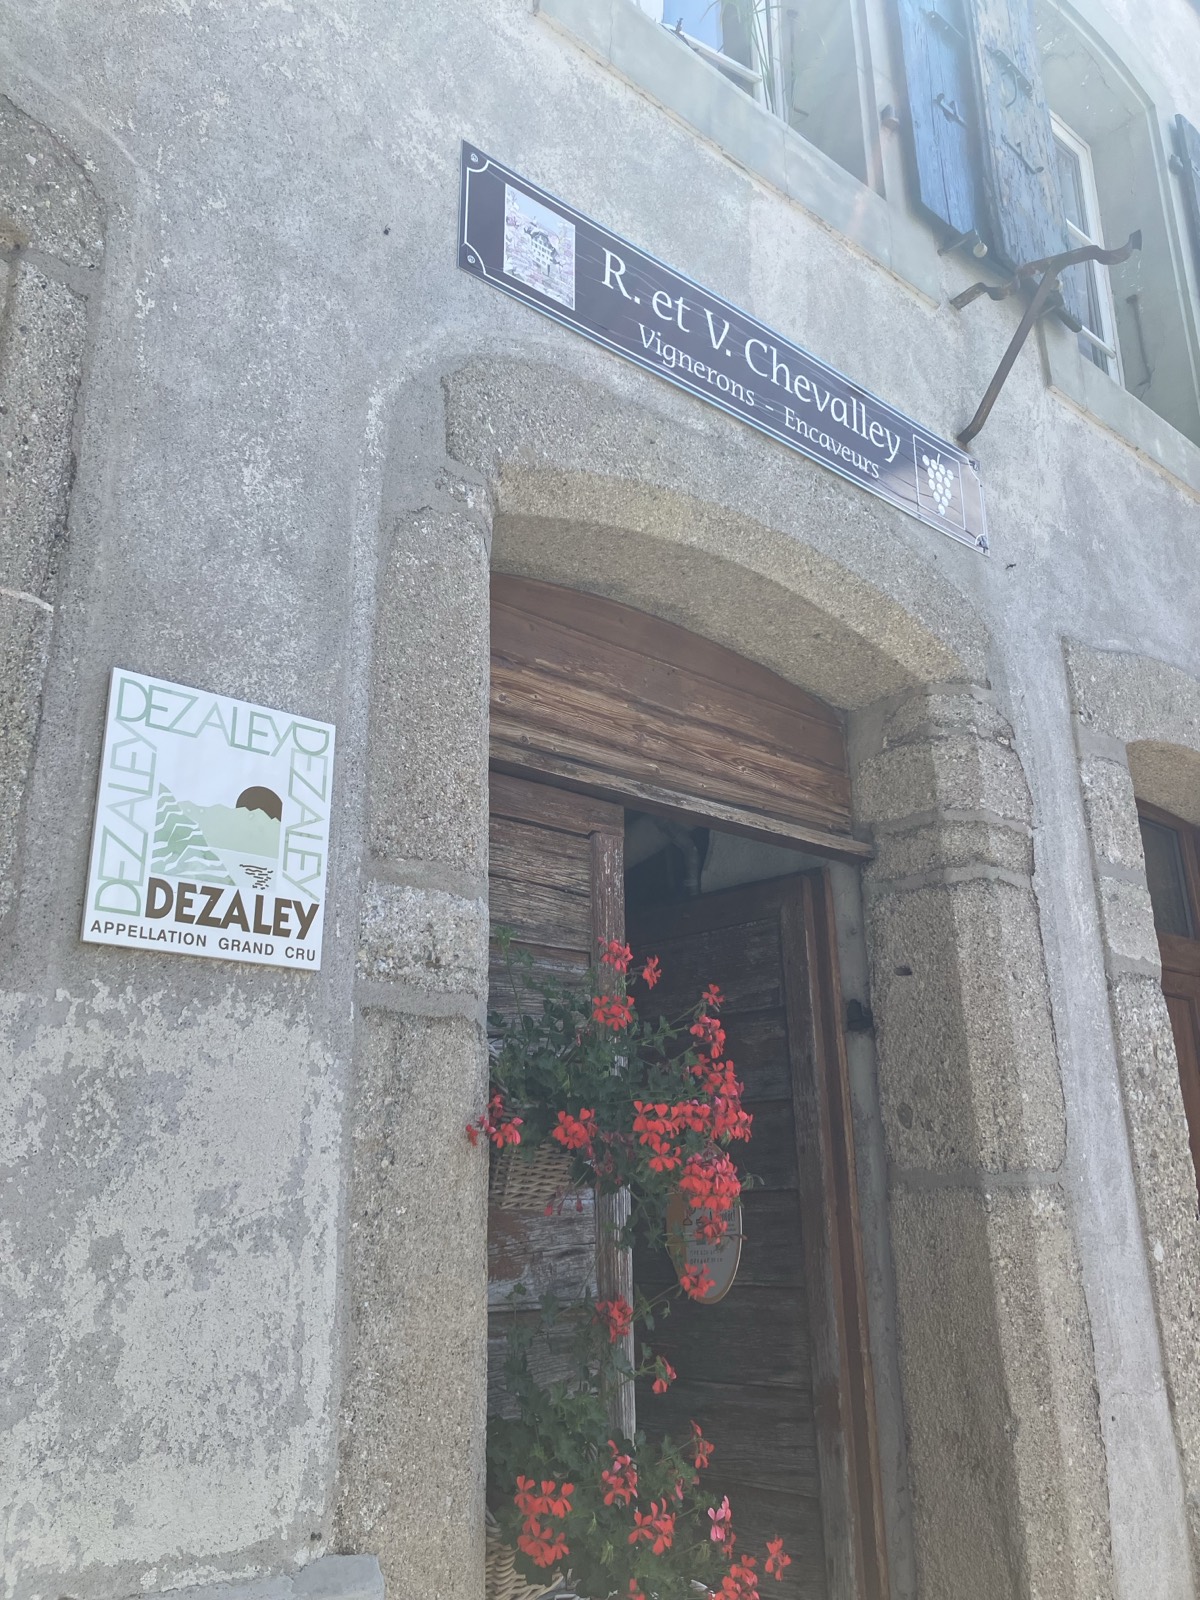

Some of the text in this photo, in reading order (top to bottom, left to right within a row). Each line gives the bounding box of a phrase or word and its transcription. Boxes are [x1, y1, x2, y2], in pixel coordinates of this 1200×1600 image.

[602, 247, 900, 463] R. et V. Chevalley
[638, 322, 755, 407] Vignerons
[784, 406, 880, 478] Encaveurs
[115, 676, 295, 757] DEZALEY
[94, 719, 158, 917] DEZALEY
[282, 721, 330, 903] DEZALEY
[90, 919, 316, 962] APPELLATION GRAND CRU
[145, 876, 320, 940] DEZALEY
